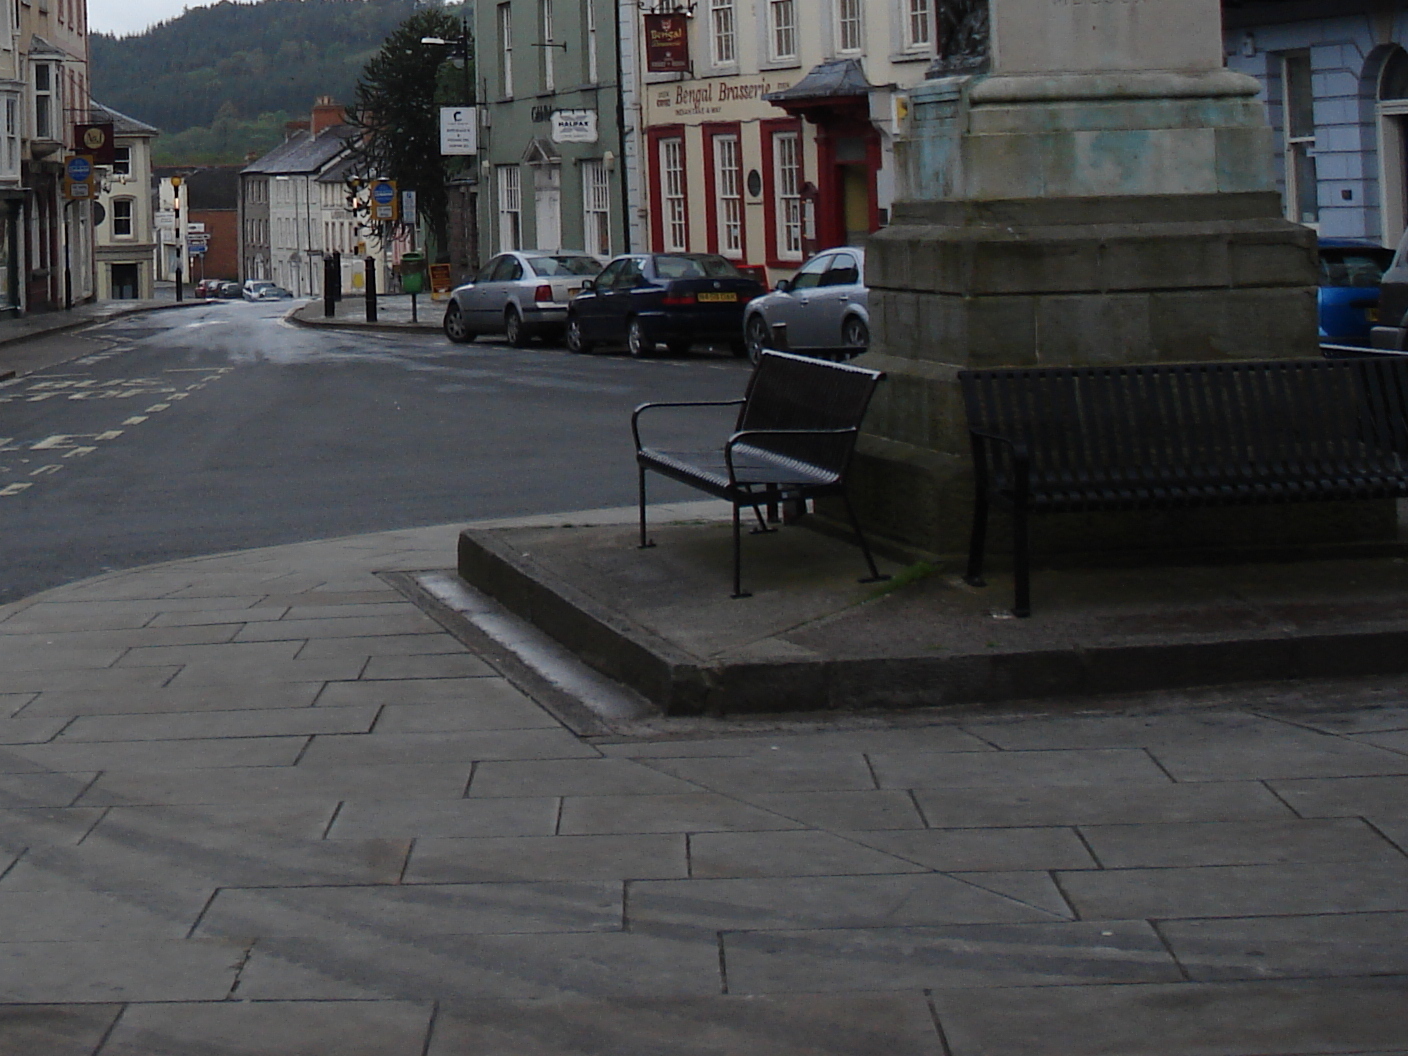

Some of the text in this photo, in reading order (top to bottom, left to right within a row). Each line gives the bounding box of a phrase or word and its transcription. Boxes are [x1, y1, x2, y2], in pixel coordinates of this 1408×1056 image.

[650, 28, 683, 42] Bengal
[674, 83, 712, 111] Bengal
[718, 77, 771, 103] Brasserie
[25, 377, 163, 391] BUS
